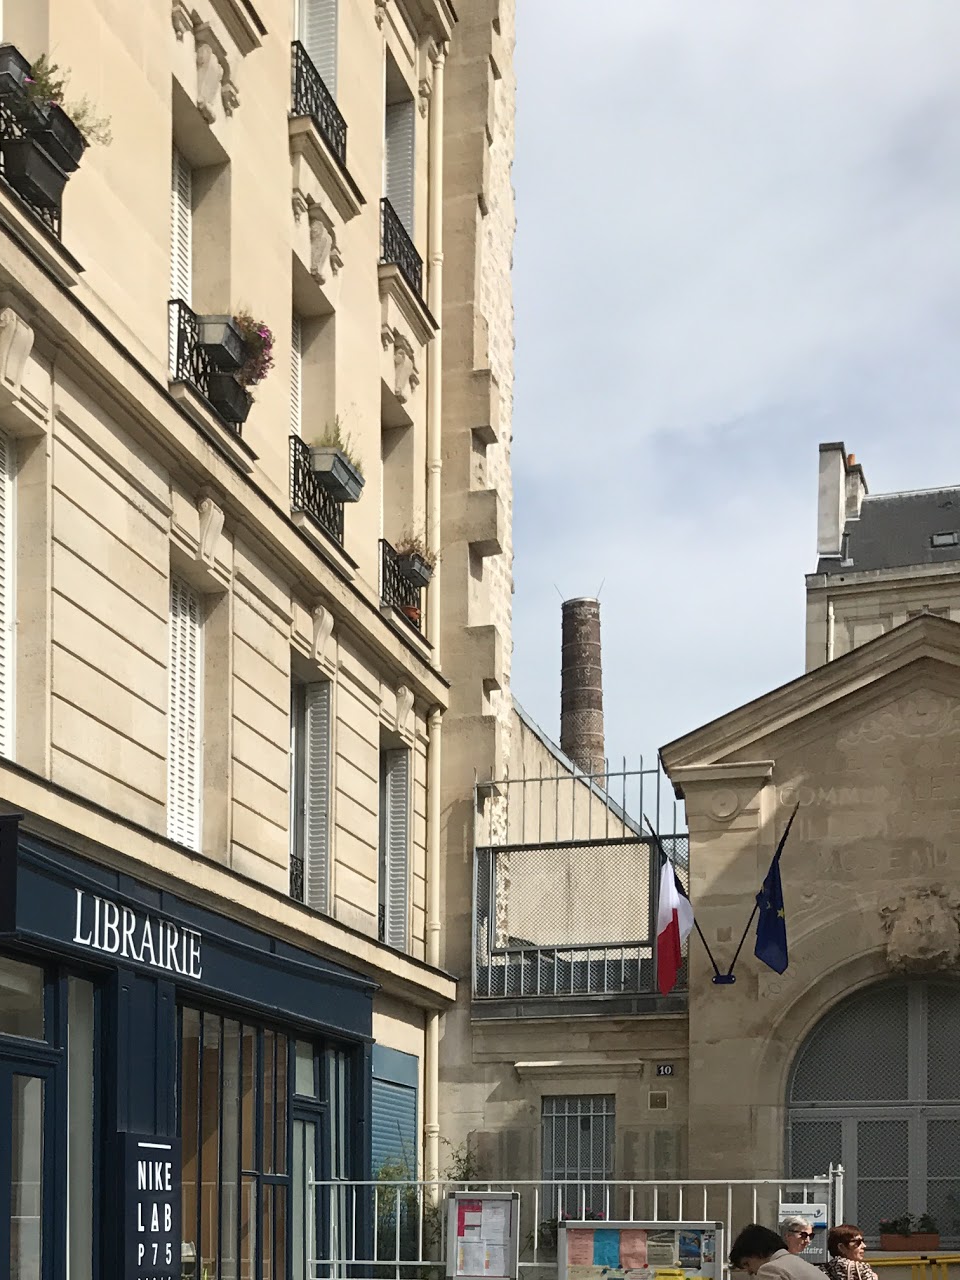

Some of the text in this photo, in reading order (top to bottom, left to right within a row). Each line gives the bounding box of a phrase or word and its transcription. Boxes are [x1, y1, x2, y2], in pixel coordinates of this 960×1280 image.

[72, 888, 202, 980] LIBRAIRIE
[659, 1065, 672, 1075] 10
[137, 1160, 172, 1191] NIKE
[137, 1202, 172, 1232] LAB
